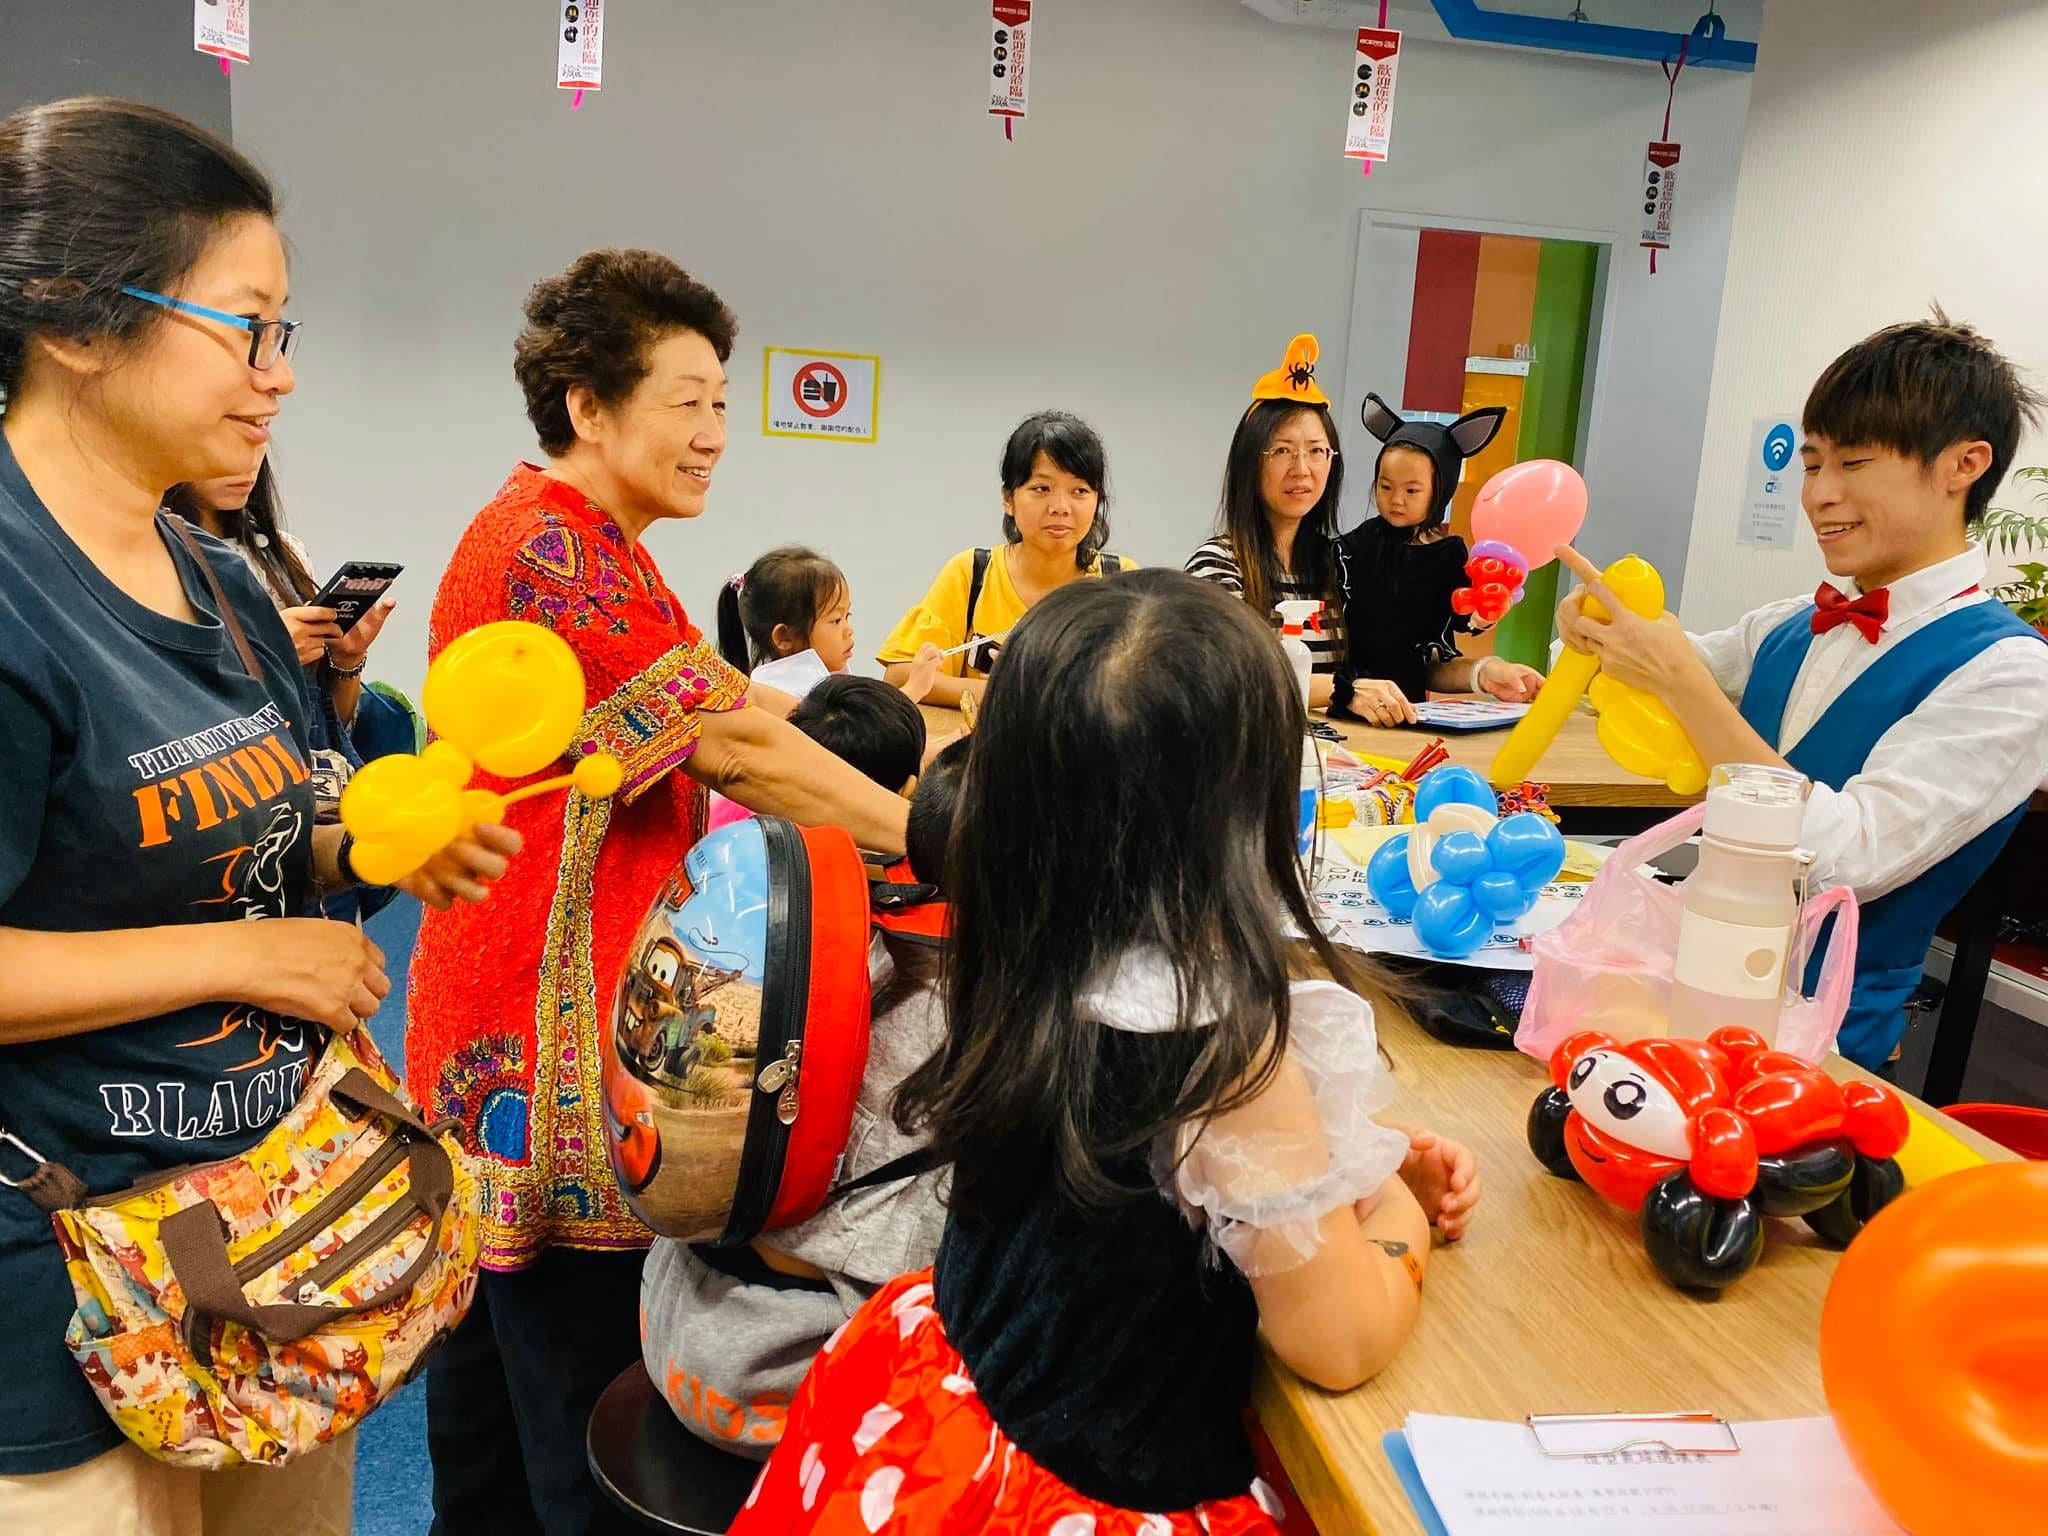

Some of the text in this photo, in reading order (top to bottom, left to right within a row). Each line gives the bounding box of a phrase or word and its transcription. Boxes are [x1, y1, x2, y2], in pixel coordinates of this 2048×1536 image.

[128, 738, 192, 780] THE
[132, 734, 312, 848] FINDL
[667, 1355, 788, 1441] KIDS
